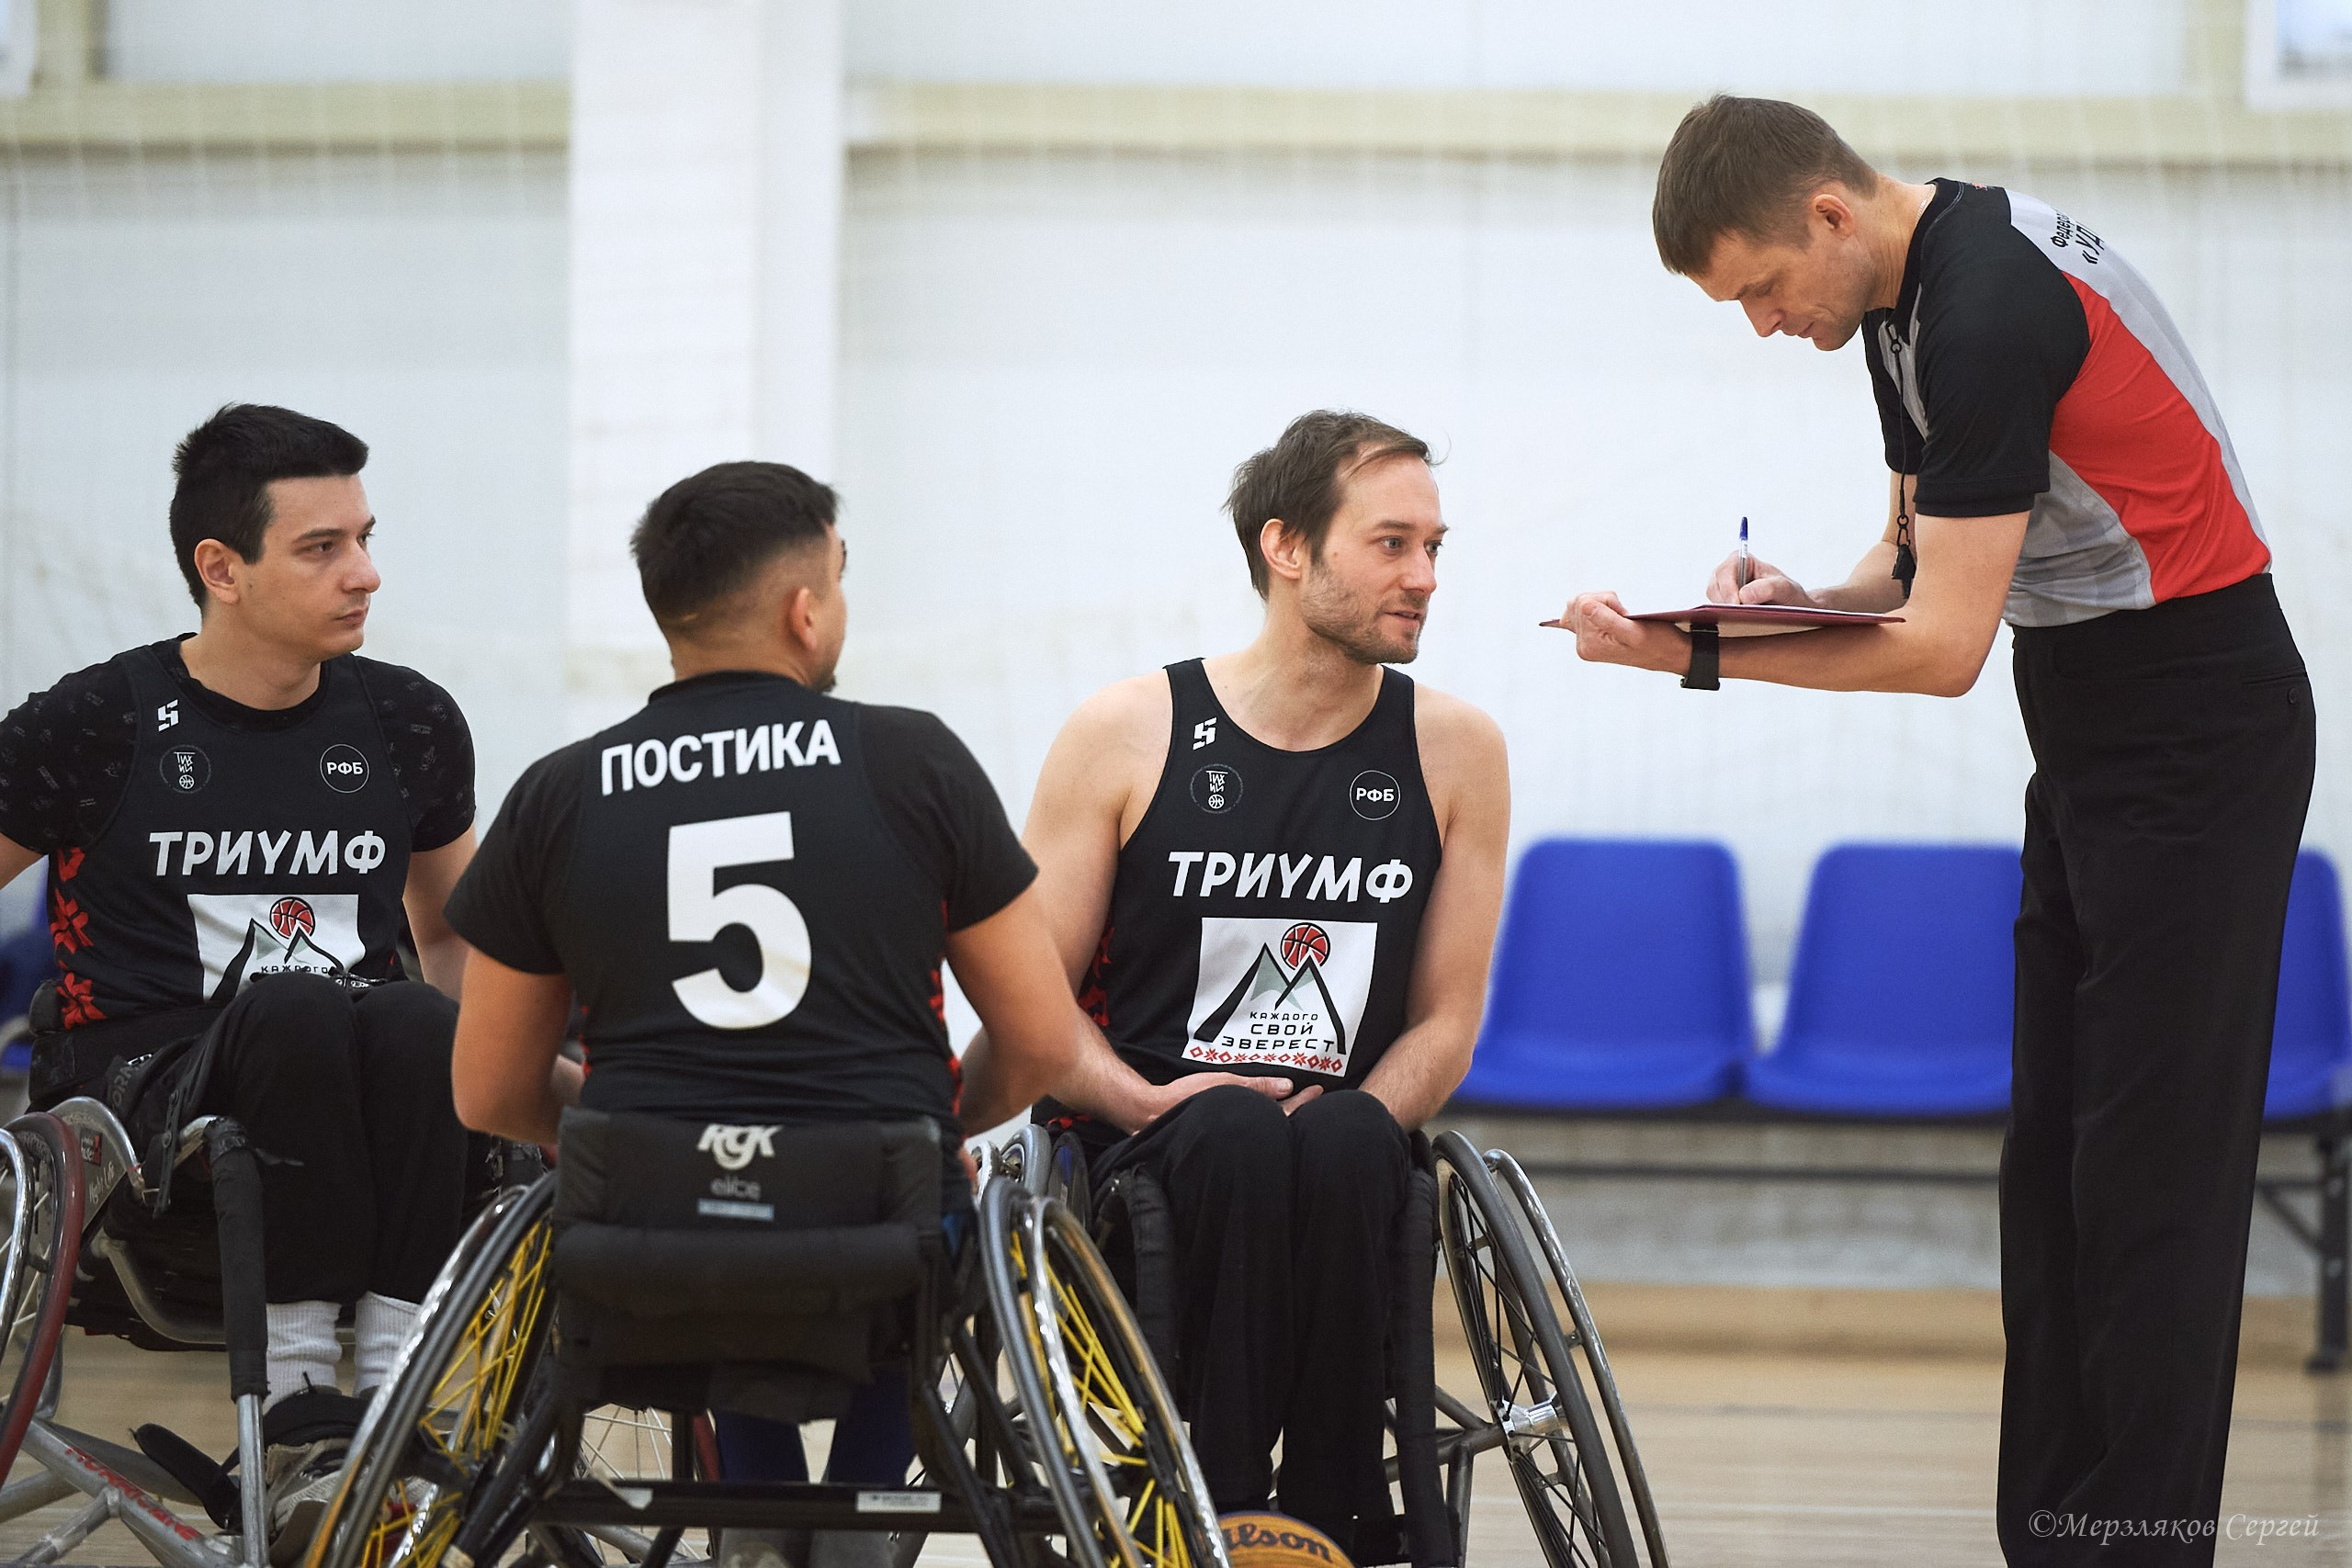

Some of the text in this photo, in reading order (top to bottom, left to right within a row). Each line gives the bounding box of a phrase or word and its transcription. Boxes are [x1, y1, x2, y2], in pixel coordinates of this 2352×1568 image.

[326, 761, 364, 775] РФБ
[600, 718, 842, 796] ПОСТИКА
[1356, 787, 1395, 803] РФБ
[149, 829, 386, 876] ТРИУМФ
[1168, 851, 1413, 904] ТРИУМФ
[667, 811, 812, 1030] 5
[1250, 1011, 1318, 1021] КАЖДОГО
[1250, 1021, 1314, 1035] СВОЙ
[1221, 1035, 1335, 1053] ЭВЕРЕСТ
[1222, 1522, 1333, 1563] ilson
